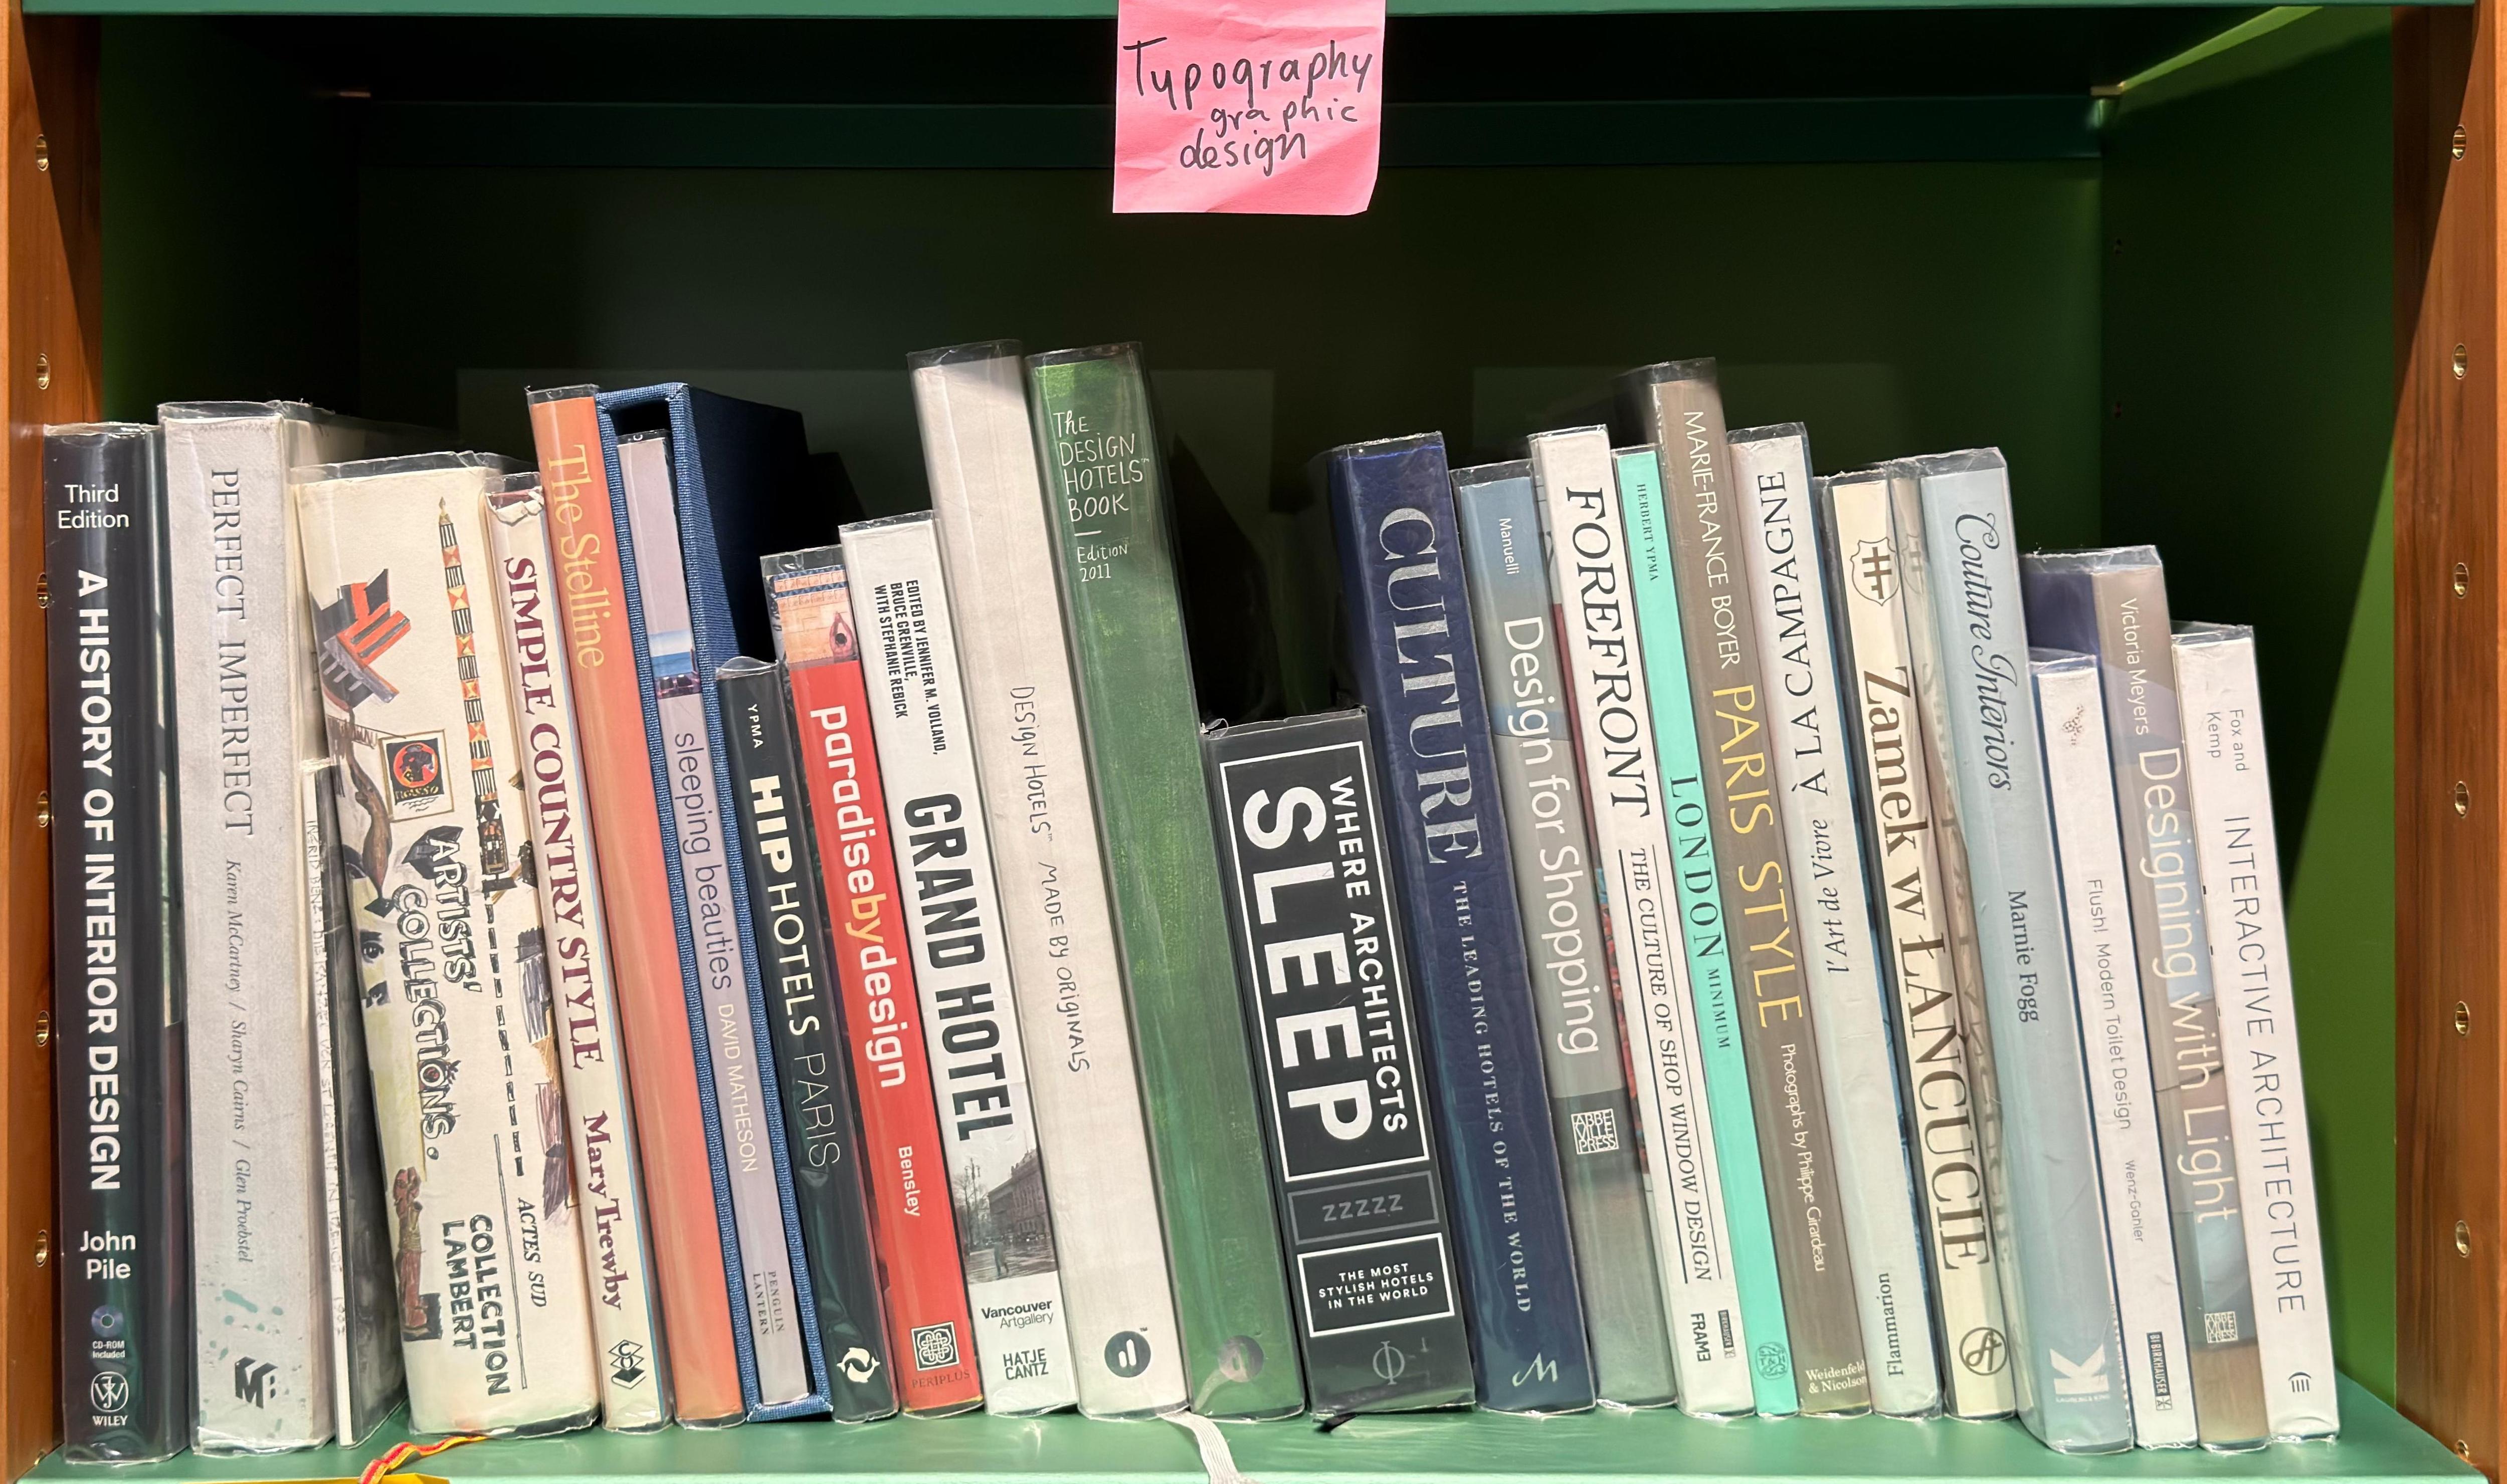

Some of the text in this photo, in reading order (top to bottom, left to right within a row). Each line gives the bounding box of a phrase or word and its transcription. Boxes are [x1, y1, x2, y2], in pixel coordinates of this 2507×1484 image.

[1123, 37, 1372, 110] Typography
[1211, 98, 1358, 138] graphic
[1181, 128, 1305, 176] design
[58, 511, 129, 529] Edition
[65, 485, 119, 503] Third
[1069, 493, 1128, 522] BOOK
[1637, 484, 1659, 581] HERBERT YPMA
[1683, 411, 1740, 670] MARIE-FRANCE BOYER
[547, 444, 612, 670] The Stelline
[1080, 563, 1111, 582] 2011
[1498, 518, 1519, 576] Manuelli
[1955, 513, 1999, 641] Couture
[211, 468, 254, 837] PERFECT IMPERFECT
[874, 584, 908, 718] WITH STEPHANIE REBICK
[890, 582, 917, 682] BRUCE GRENVILLE,
[906, 579, 946, 755] EDITED BY JENNIFER M. VOLLAND,
[1566, 487, 1650, 817] FOREFRONT
[1758, 472, 1828, 796] À LA CAMPAGNE
[2120, 597, 2149, 736] Victoria Meyers
[748, 704, 763, 749] YPMA
[1379, 508, 1483, 864] CULTURE
[1971, 645, 2017, 791] Interiors
[2207, 711, 2222, 759] Kemp
[1864, 666, 1929, 857] Zamek
[2230, 709, 2250, 771] Fox and
[504, 556, 604, 1070] SIMPLE COUNTRY STYLE
[675, 732, 733, 990] sleeping beauties
[1504, 616, 1601, 1055] Design for Shopping
[1712, 685, 1803, 1028] PARIS STYLE
[1811, 818, 1835, 881] Vivre
[78, 570, 120, 1190] A HISTORY OF INTERIOR DESIGN
[1038, 862, 1064, 927] MADE
[1670, 777, 1730, 1048] LONDON MINIMUM
[1818, 887, 1838, 912] de
[750, 775, 840, 1168] HIP HOTELS PARIS
[904, 793, 1013, 1141] GRAND HOTEL
[1243, 785, 1373, 1140] SLEEP
[1330, 775, 1408, 1133] WHERE ARCHITECTS
[2008, 890, 2039, 1023] Marnie Fogg
[2087, 879, 2131, 1130] Flush! Modern Toilet Design
[2139, 747, 2238, 1223] Designing with Light
[226, 858, 253, 1262] Karen McCartney Sharyn Cairns Glen Proebstel
[717, 1003, 757, 1173] DAVID MATHESON
[1453, 880, 1531, 1312] THE LEADING HOTELS OF THE WORLD
[1631, 848, 1711, 1281] THE CULTURE OF SHOP WINDOW DESIGN
[2224, 816, 2305, 1313] INTERACTIVE ARCHITECTURE
[898, 1146, 921, 1218] Bensley
[1578, 1136, 1617, 1152] PRESS
[1781, 1043, 1826, 1272] Photographs by Philippe Girardeau
[80, 1231, 136, 1251] John
[516, 1197, 547, 1307] ACTES SUD
[583, 1111, 629, 1310] Mary Trewby
[2125, 1160, 2144, 1242] Wenz-Gahler
[86, 1259, 131, 1279] Pile
[443, 1220, 477, 1349] LAMBERT
[470, 1214, 511, 1396] COLLECTION
[753, 1273, 769, 1336] LANTERN
[768, 1271, 784, 1333] PENGUIN
[981, 1299, 1053, 1320] Vancouver
[1318, 1272, 1434, 1298] STYLISH HOTELS
[1328, 1286, 1428, 1310] IN THE WORLD
[1339, 1263, 1409, 1283] THE MOST
[92, 1340, 125, 1349] CD-ROM
[92, 1350, 125, 1359] Included
[1000, 1312, 1054, 1330] Artgallery
[1003, 1348, 1046, 1368] HATJE
[1005, 1363, 1049, 1381] CANTZ
[1806, 1360, 1865, 1380] Weidenfeld
[1876, 1271, 1904, 1377] Flammarion
[93, 1415, 128, 1426] WILEY
[912, 1369, 971, 1388] PERIPLUS
[1809, 1376, 1867, 1393] & Nicolson
